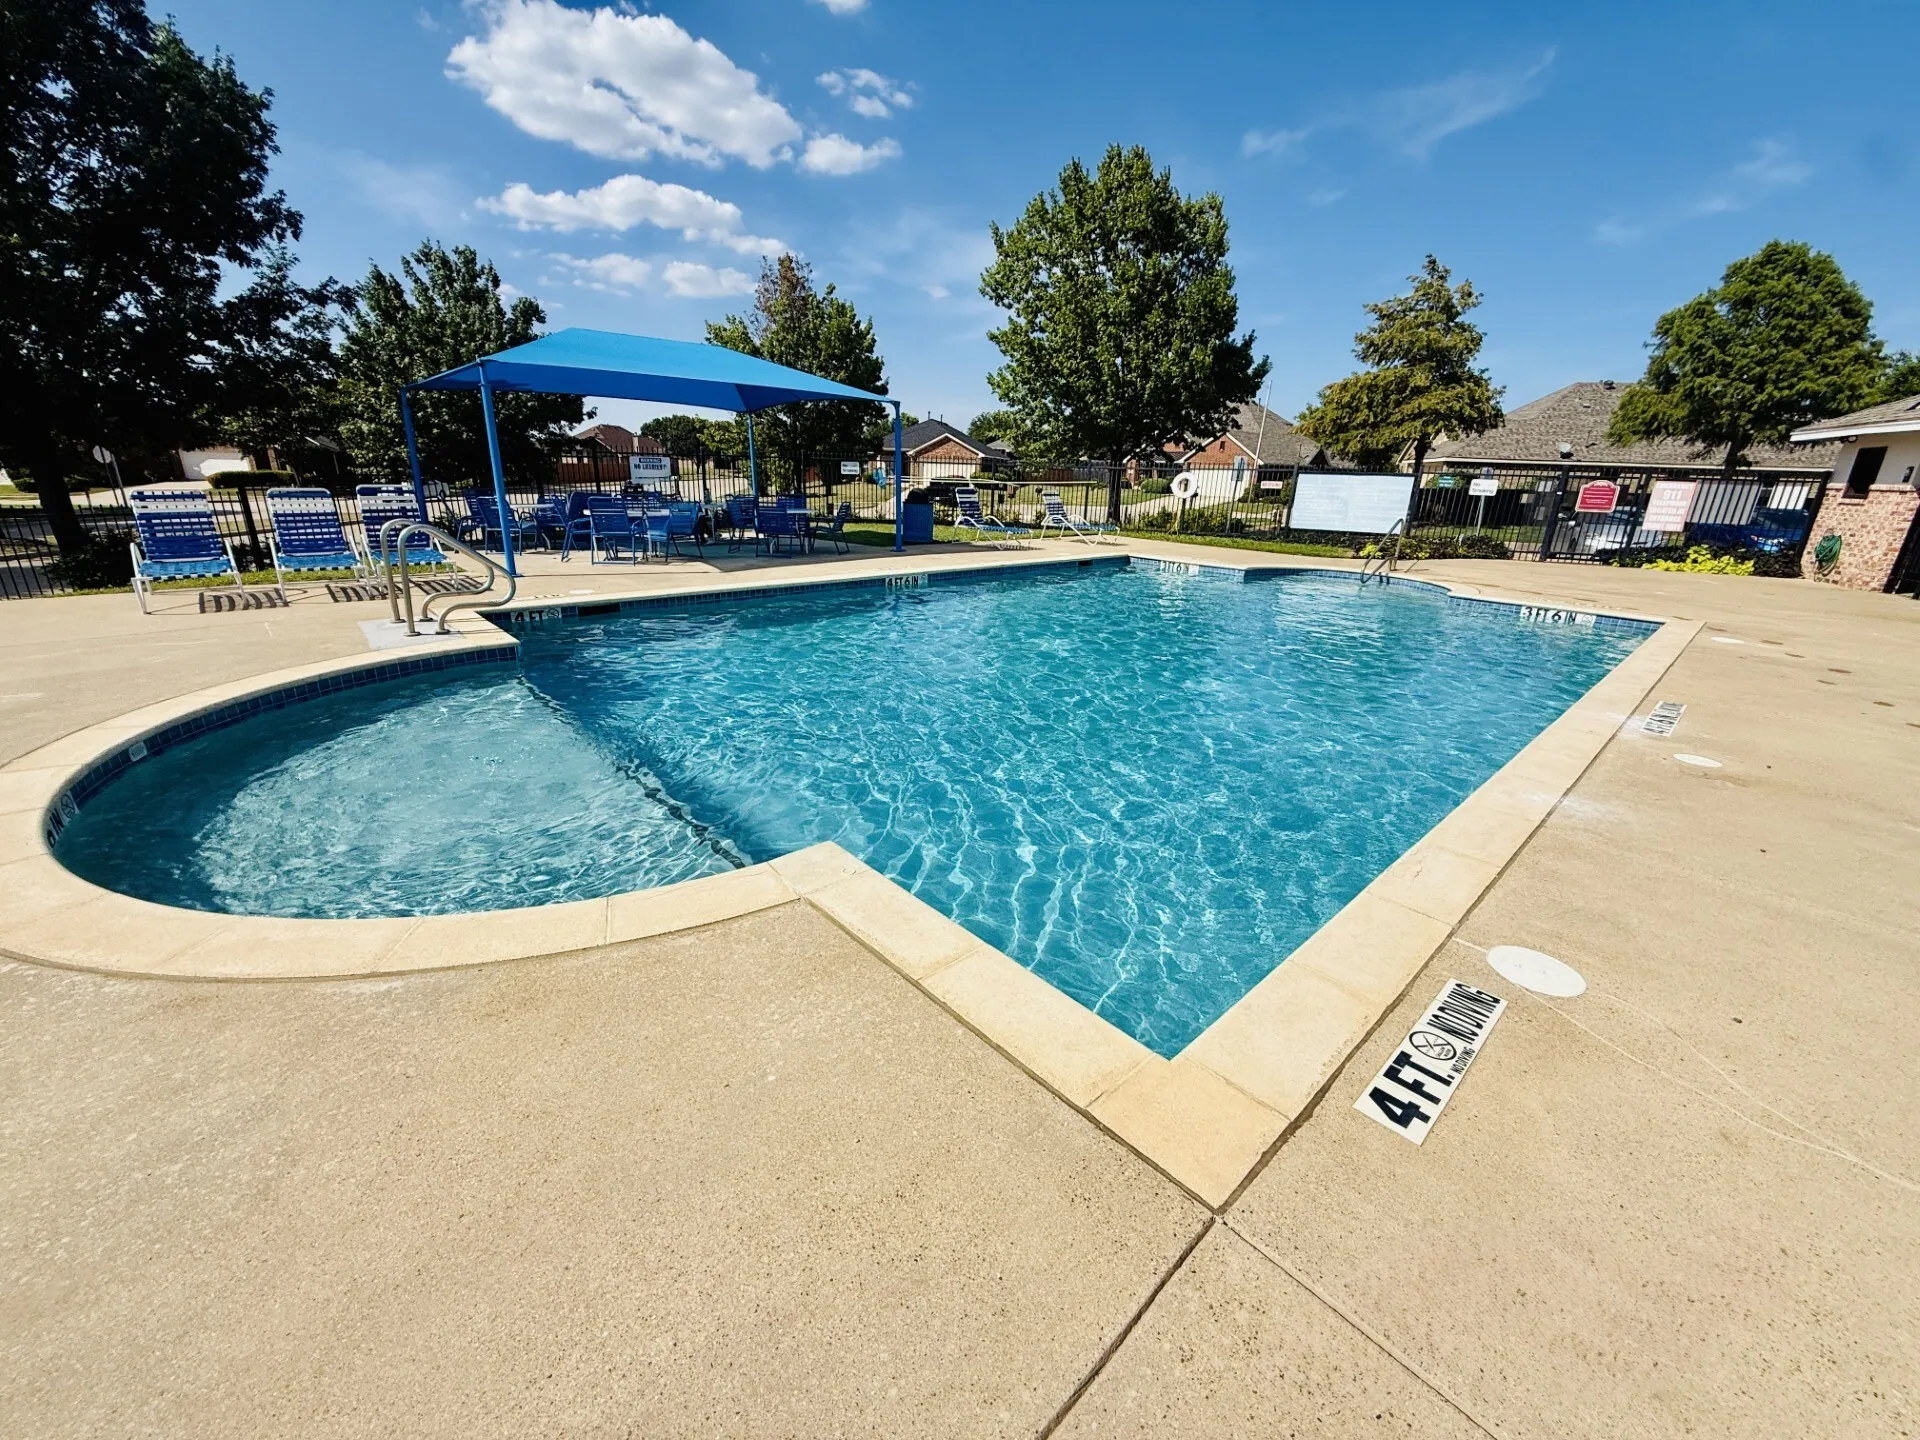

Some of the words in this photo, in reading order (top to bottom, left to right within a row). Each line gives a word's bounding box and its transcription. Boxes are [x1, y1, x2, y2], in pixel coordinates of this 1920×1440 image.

[1662, 489, 1683, 500] 911
[514, 611, 525, 621] 4
[528, 610, 544, 621] FT
[1551, 611, 1562, 622] 6
[1437, 983, 1501, 1030] DIVING
[1427, 1014, 1479, 1045] NO
[1454, 1046, 1476, 1067] DIVING
[1383, 1050, 1455, 1106] FT.
[1368, 1086, 1431, 1129] 4
